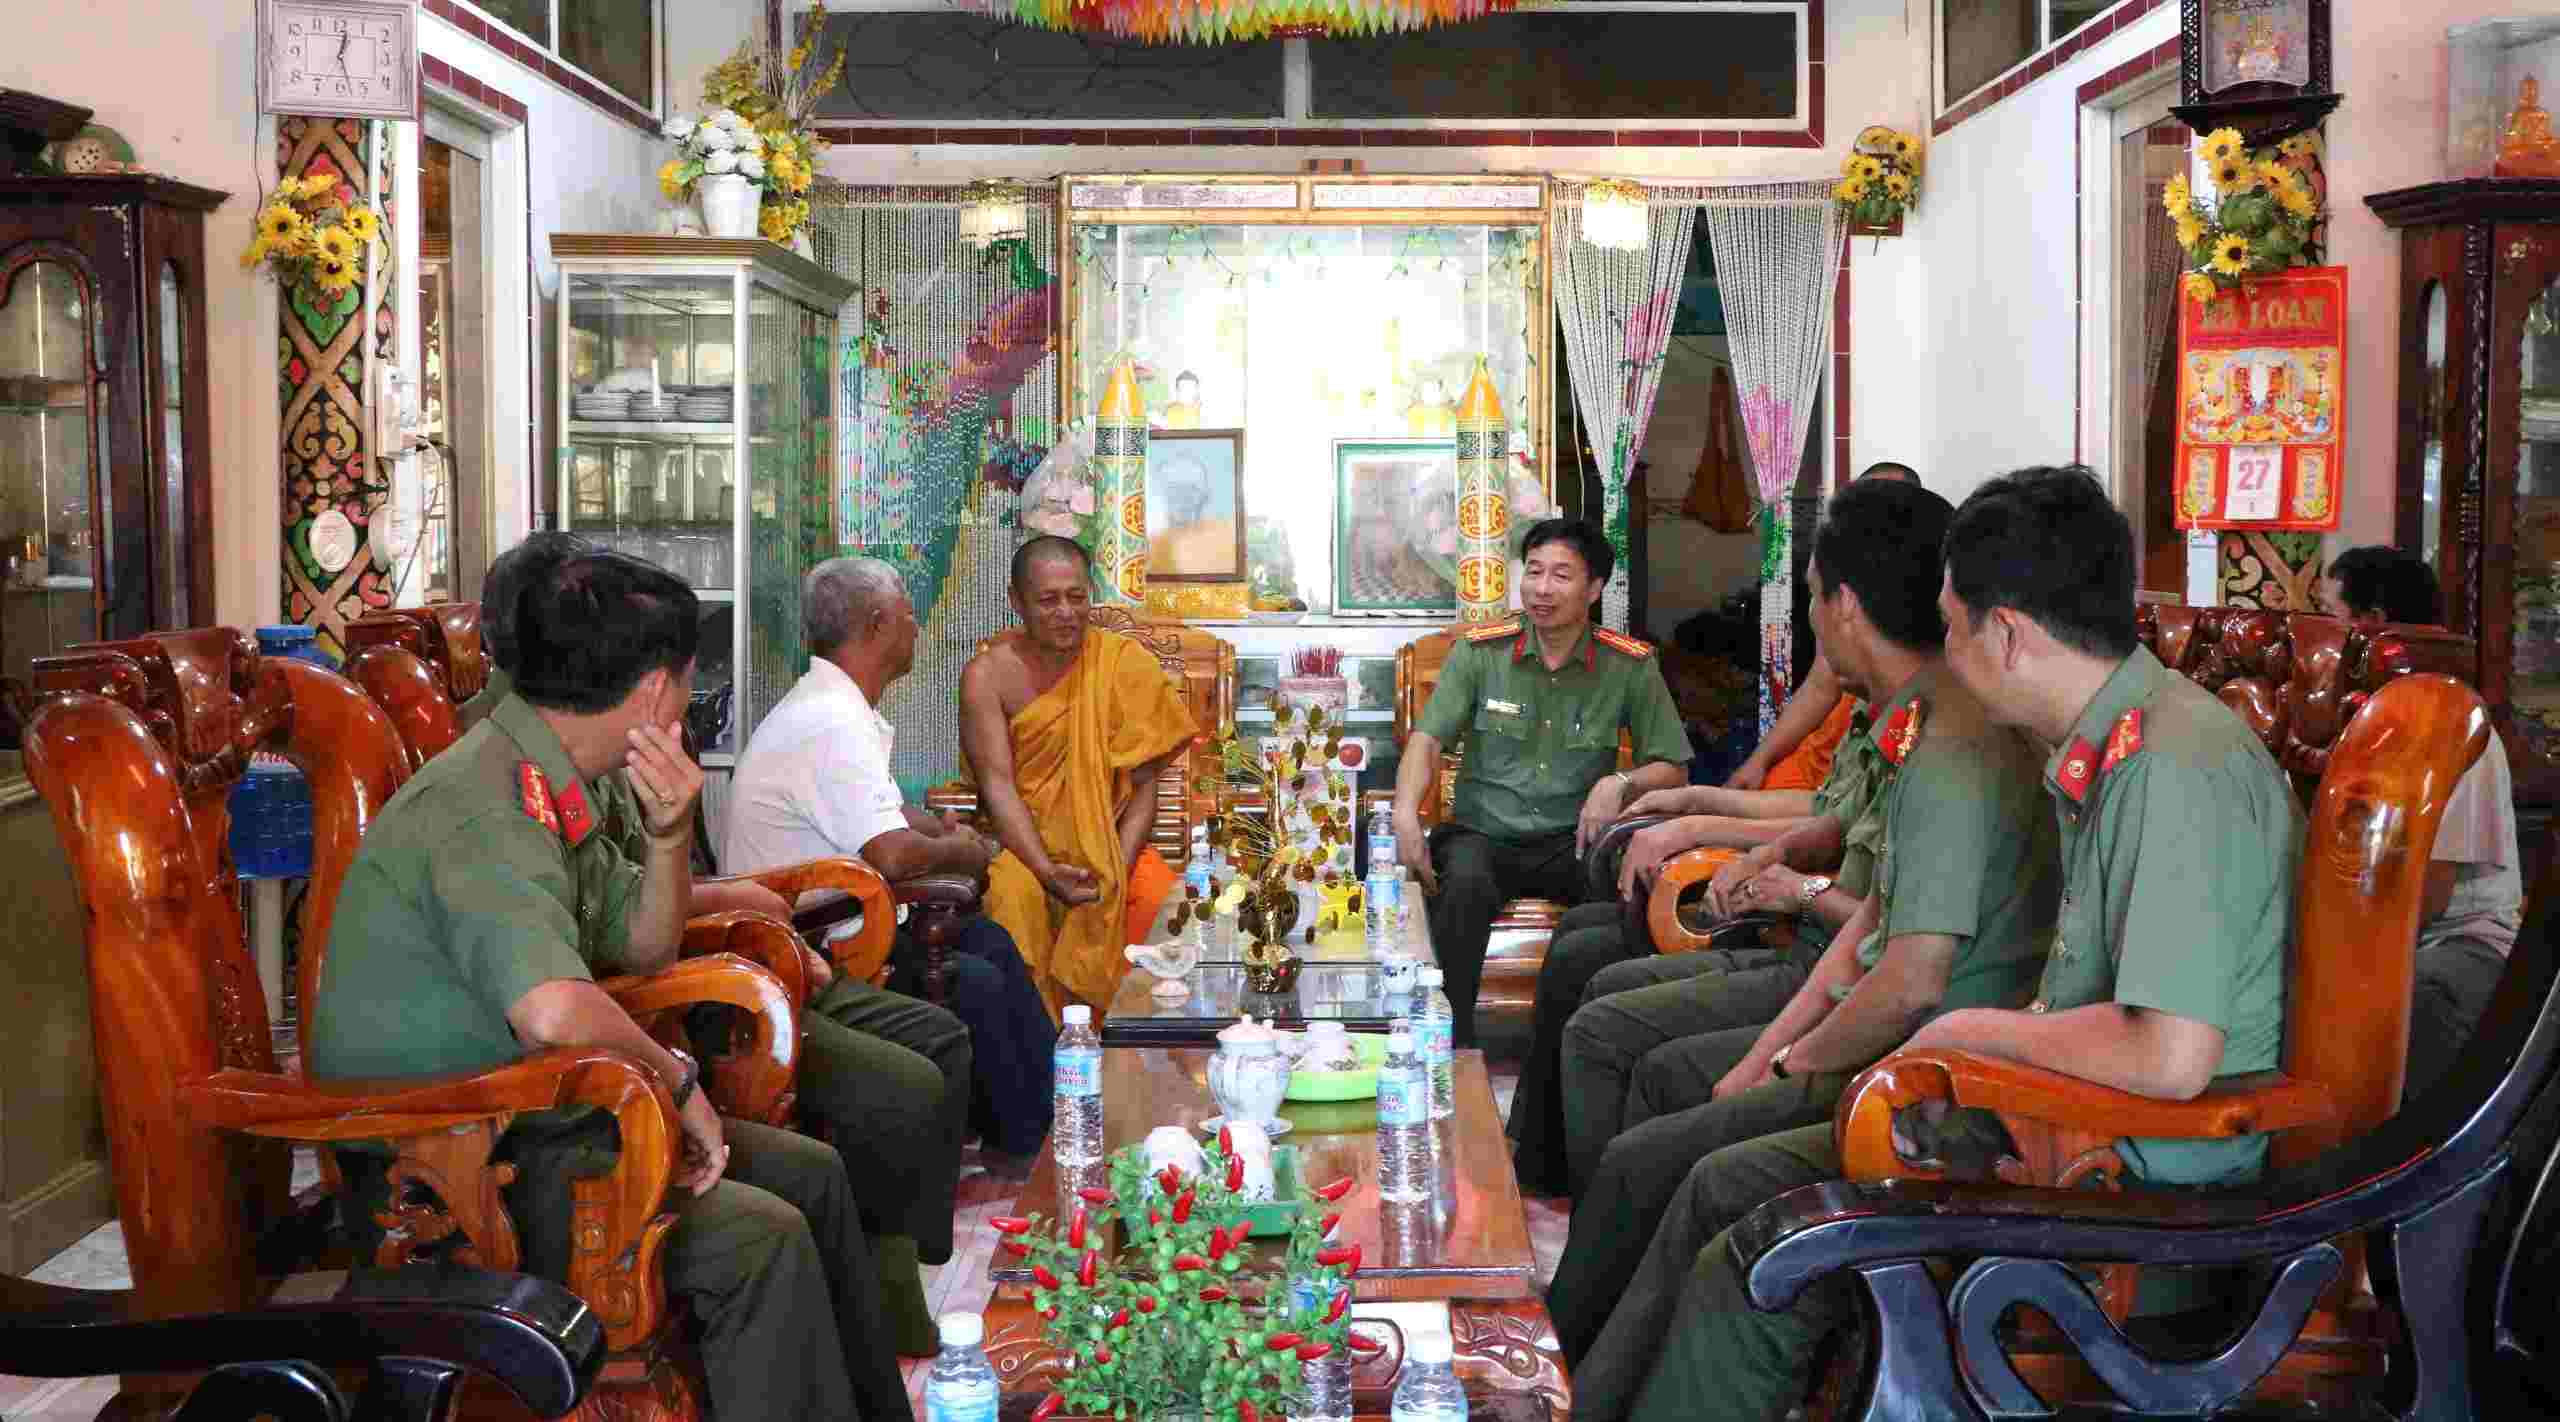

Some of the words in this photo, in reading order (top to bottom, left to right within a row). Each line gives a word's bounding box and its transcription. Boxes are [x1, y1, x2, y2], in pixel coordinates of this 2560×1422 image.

[312, 17, 322, 31] 11
[334, 19, 347, 33] 12
[382, 25, 392, 43] 2
[289, 46, 301, 57] 9
[381, 74, 391, 91] 4
[2250, 297, 2326, 329] LOAN
[2238, 459, 2271, 491] 27
